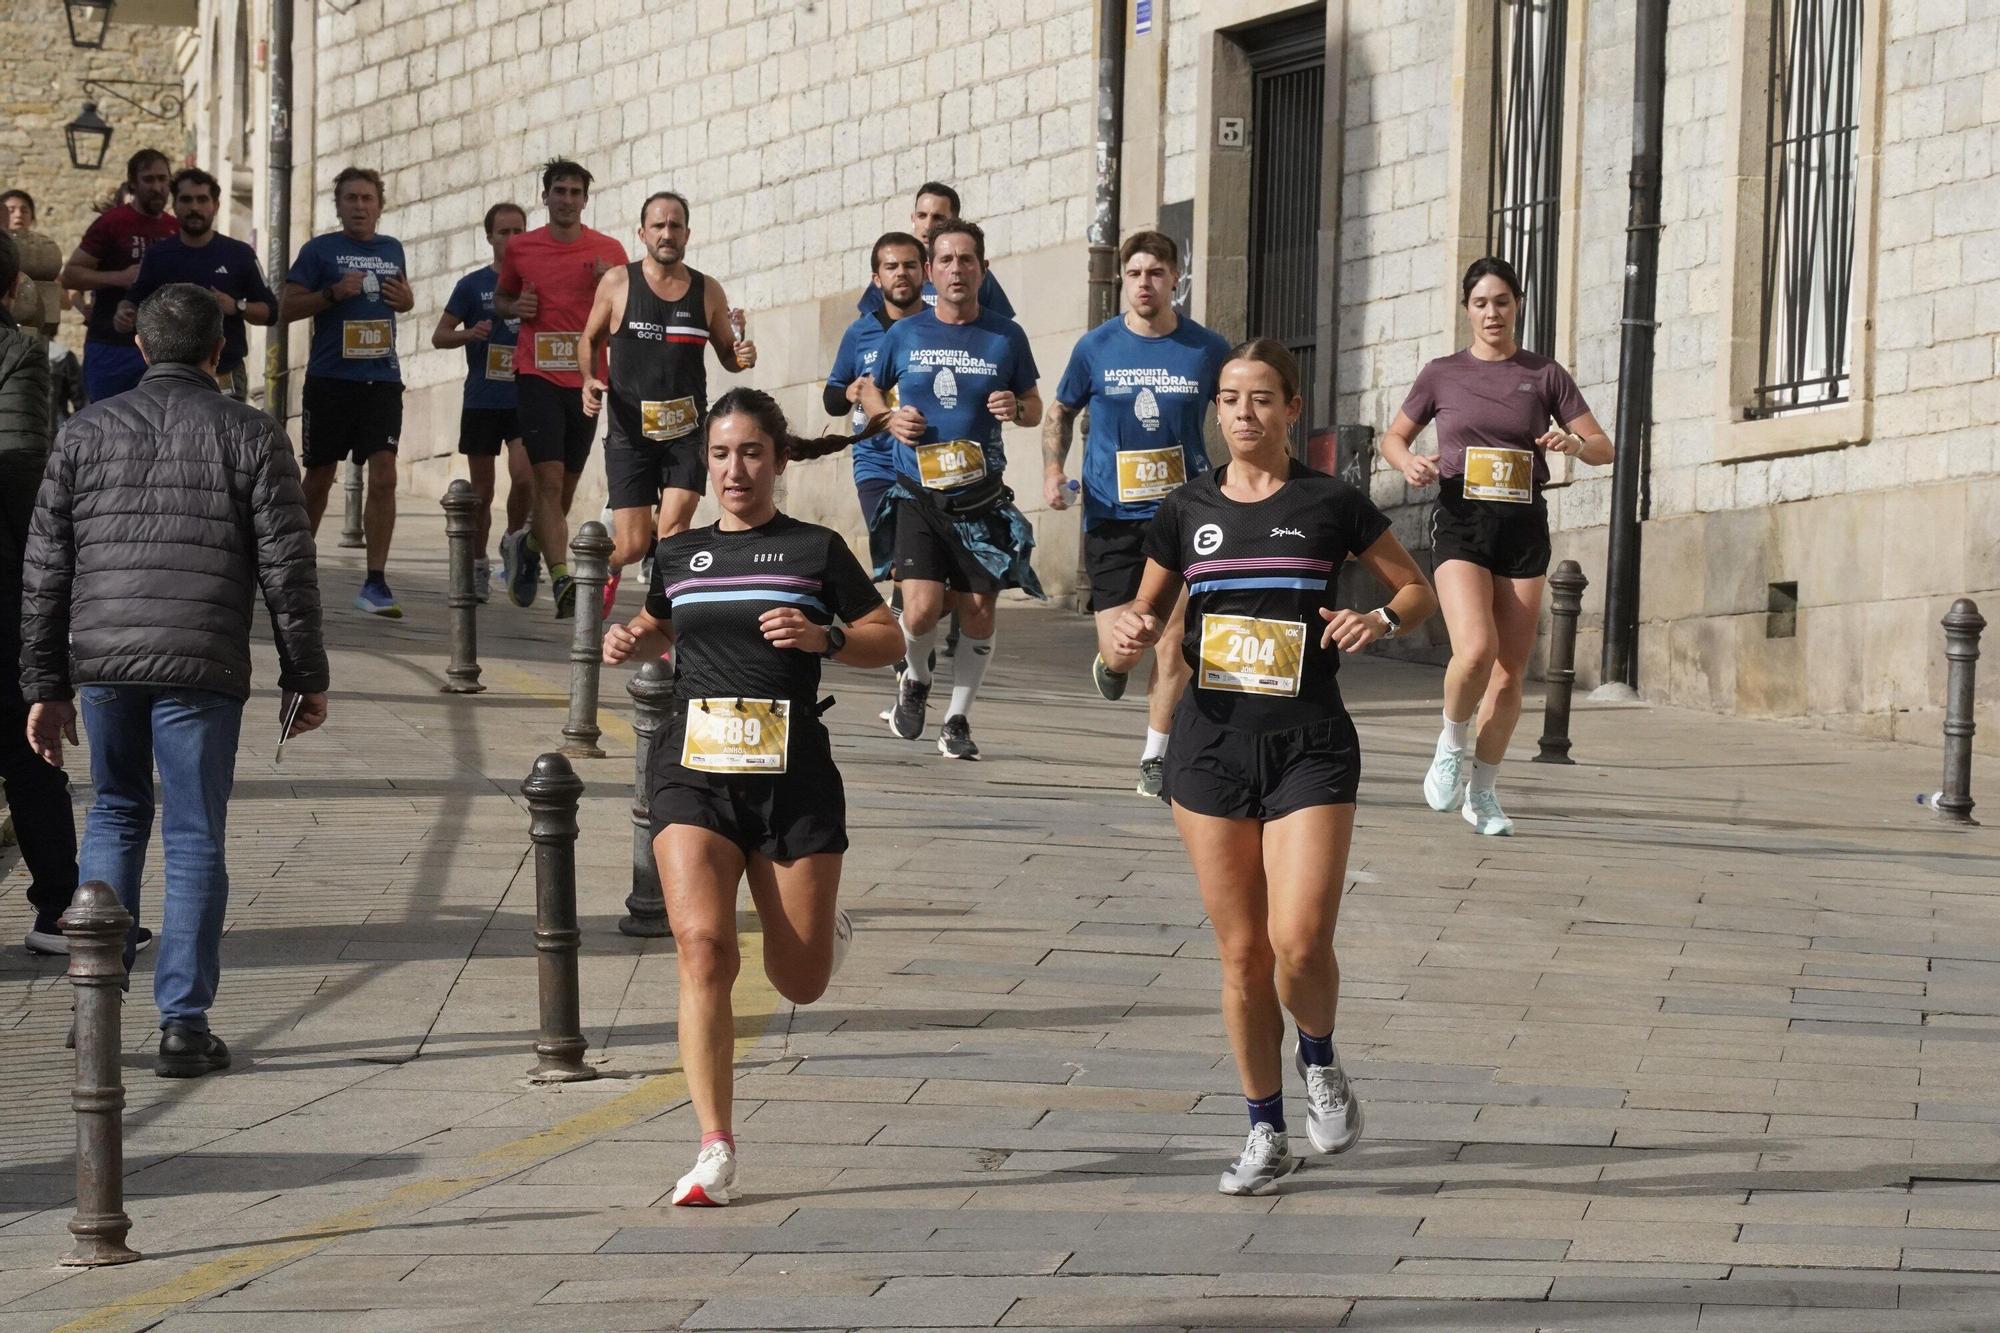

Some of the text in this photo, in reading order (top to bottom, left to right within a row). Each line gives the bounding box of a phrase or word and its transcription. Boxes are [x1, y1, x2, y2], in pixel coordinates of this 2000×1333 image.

[1224, 121, 1238, 142] 5
[358, 329, 381, 345] 706
[551, 342, 573, 356] 128
[919, 349, 969, 358] CONQUISTA
[920, 356, 986, 367] ALMENDRA
[955, 366, 998, 376] KONKISTA
[1104, 368, 1169, 377] LA CONQUISTA
[1118, 375, 1188, 386] ALMENDRA
[1155, 385, 1199, 394] KONKISTA
[656, 409, 685, 427] 365
[937, 450, 967, 472] 194
[1136, 461, 1169, 482] 428
[1492, 461, 1513, 481] 37
[1270, 527, 1306, 538] Spiuk
[1226, 634, 1275, 666] 204
